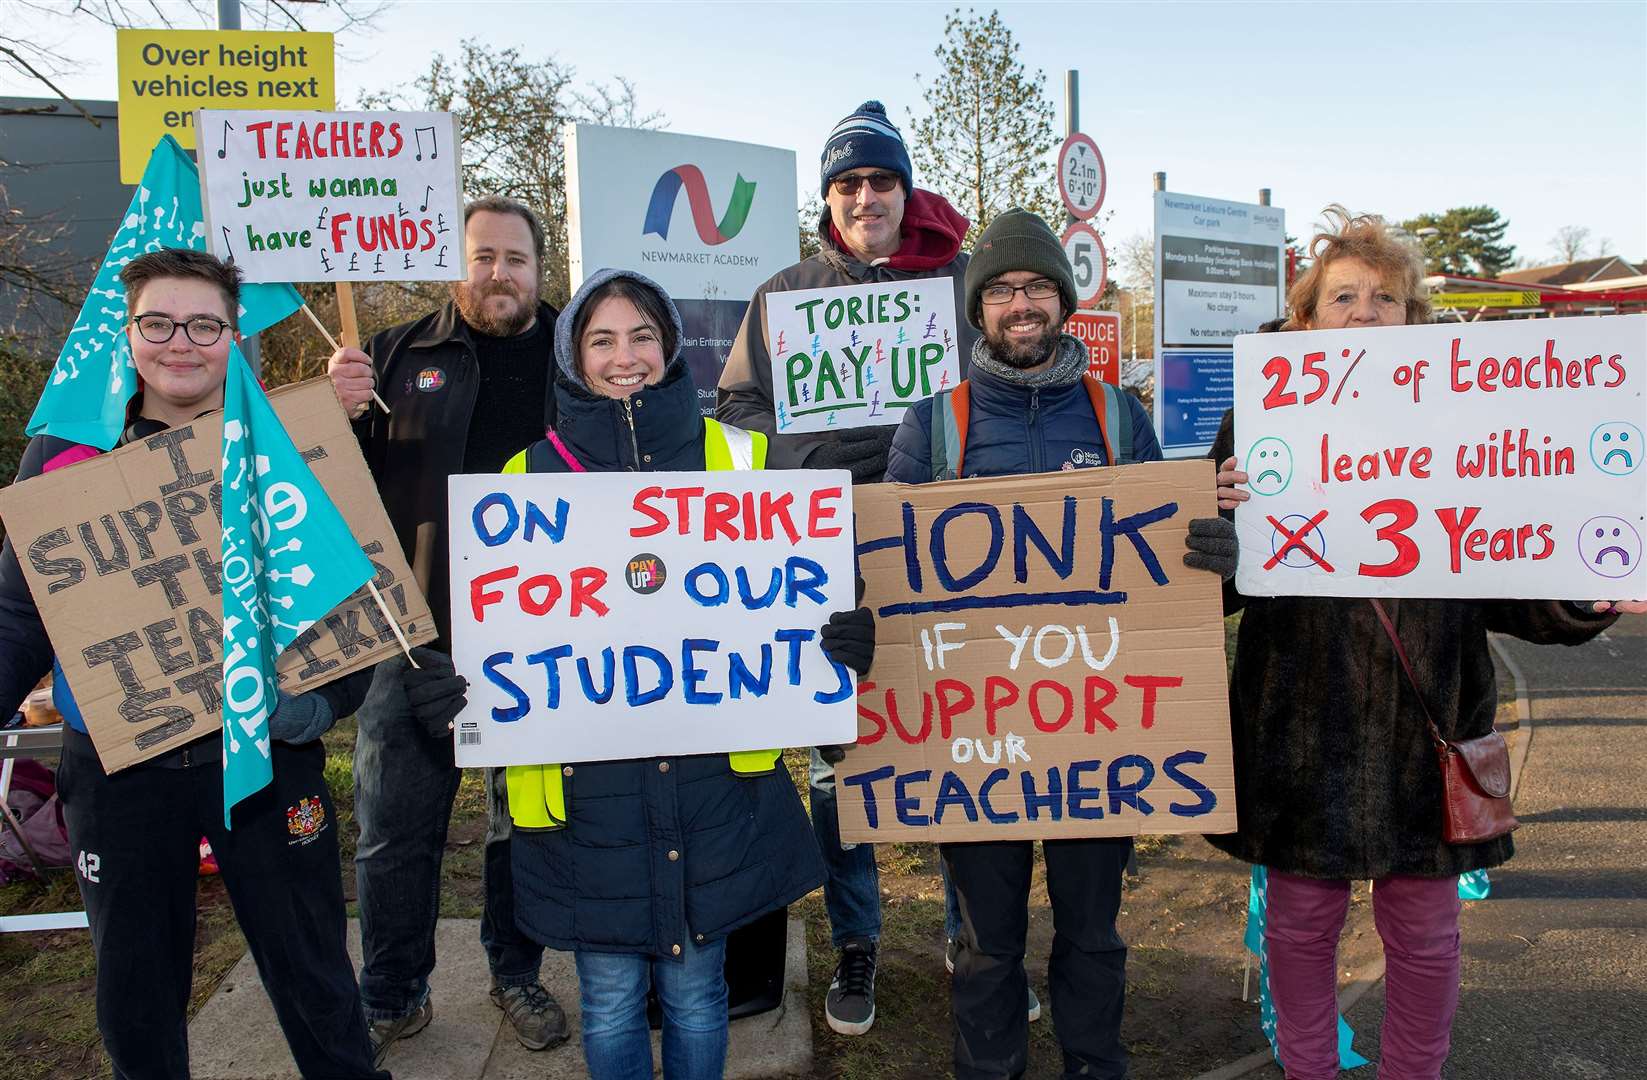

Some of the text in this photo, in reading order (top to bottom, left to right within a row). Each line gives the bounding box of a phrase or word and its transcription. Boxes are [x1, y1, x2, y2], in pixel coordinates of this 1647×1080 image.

[142, 42, 307, 71] Over height
[132, 74, 319, 98] vehicles next
[164, 109, 195, 127] en
[246, 121, 404, 159] TEACHERS
[1070, 157, 1096, 180] 2.1m
[237, 172, 398, 207] just wanna
[1164, 199, 1248, 218] Newmarket Leisure Centre
[1193, 216, 1220, 229] Car park
[246, 212, 436, 253] have FUNDS
[641, 250, 759, 268] NEWMARKET ACADEMY
[1073, 242, 1093, 289] 5
[1188, 288, 1218, 300] Maximum
[1207, 303, 1217, 312] No
[795, 291, 920, 335] TORIES:
[683, 337, 733, 347] ain Entrance
[1190, 328, 1199, 337] No
[1200, 329, 1220, 337] return
[420, 370, 440, 378] PAY
[786, 343, 945, 407] PAY UP
[1261, 338, 1626, 410] 25% of teachers
[145, 425, 215, 496] I
[1320, 428, 1575, 483] leave within
[472, 486, 843, 547] ON STRIKE
[854, 495, 1179, 594] HONK
[1358, 498, 1555, 577] 3 Years
[629, 559, 657, 573] PAY
[470, 556, 829, 623] FOR OUR
[920, 616, 1119, 671] IF YOU
[482, 628, 854, 723] STUDENTS
[856, 675, 1184, 746] SUPPORT
[951, 731, 1031, 764] OUR
[843, 749, 1218, 829] TEACHERS
[77, 850, 101, 883] 42
